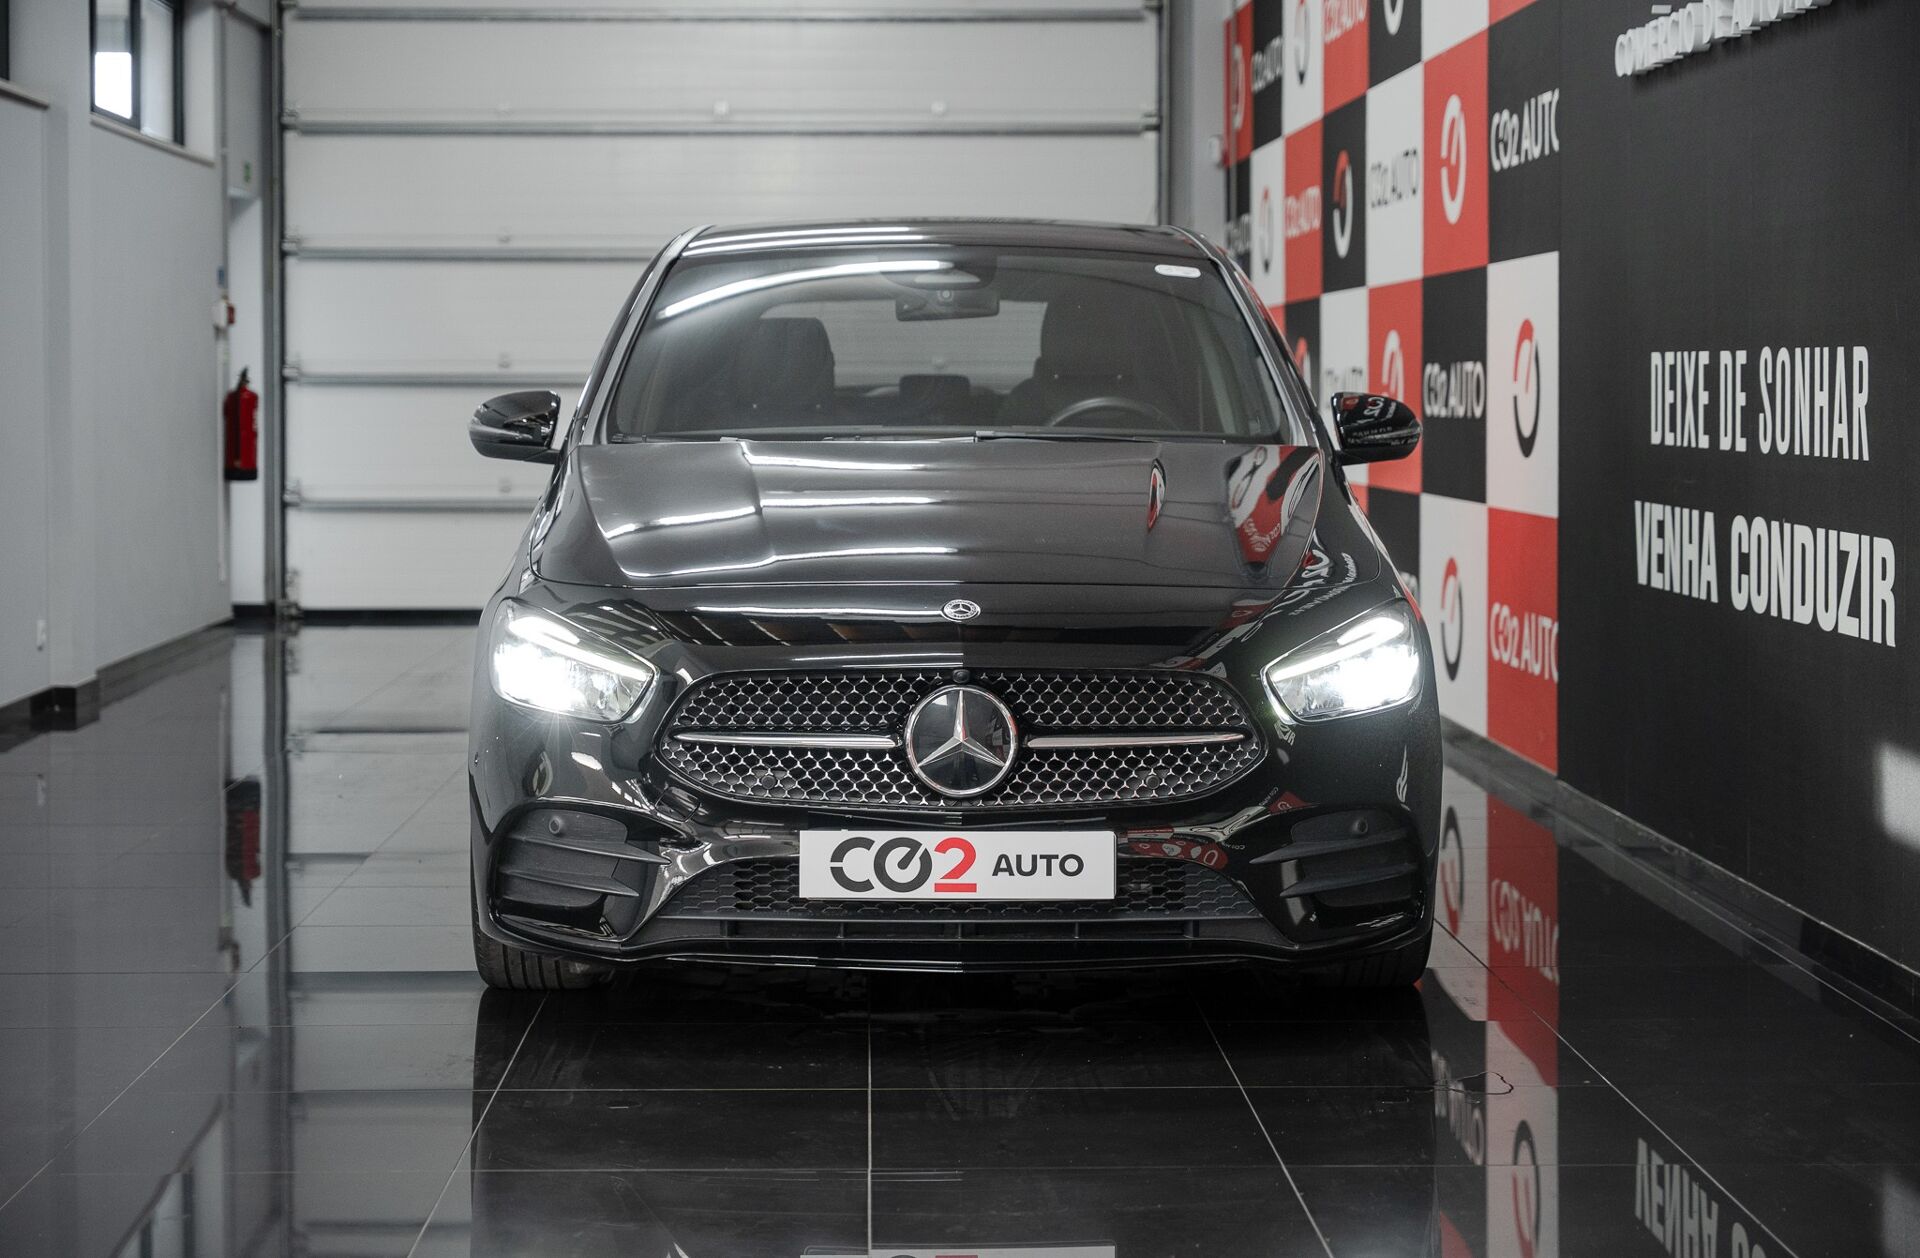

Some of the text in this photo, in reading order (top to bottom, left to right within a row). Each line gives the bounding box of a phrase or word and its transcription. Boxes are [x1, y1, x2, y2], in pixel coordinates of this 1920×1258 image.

[1490, 108, 1520, 172] CO2
[1448, 360, 1486, 419] AUTO
[1651, 346, 1869, 461] DEIXE DE SONHAR
[1634, 500, 1896, 647] VENHA CONDUZIR
[1490, 602, 1520, 668] CO2
[830, 836, 1084, 893] CO2 AUTO
